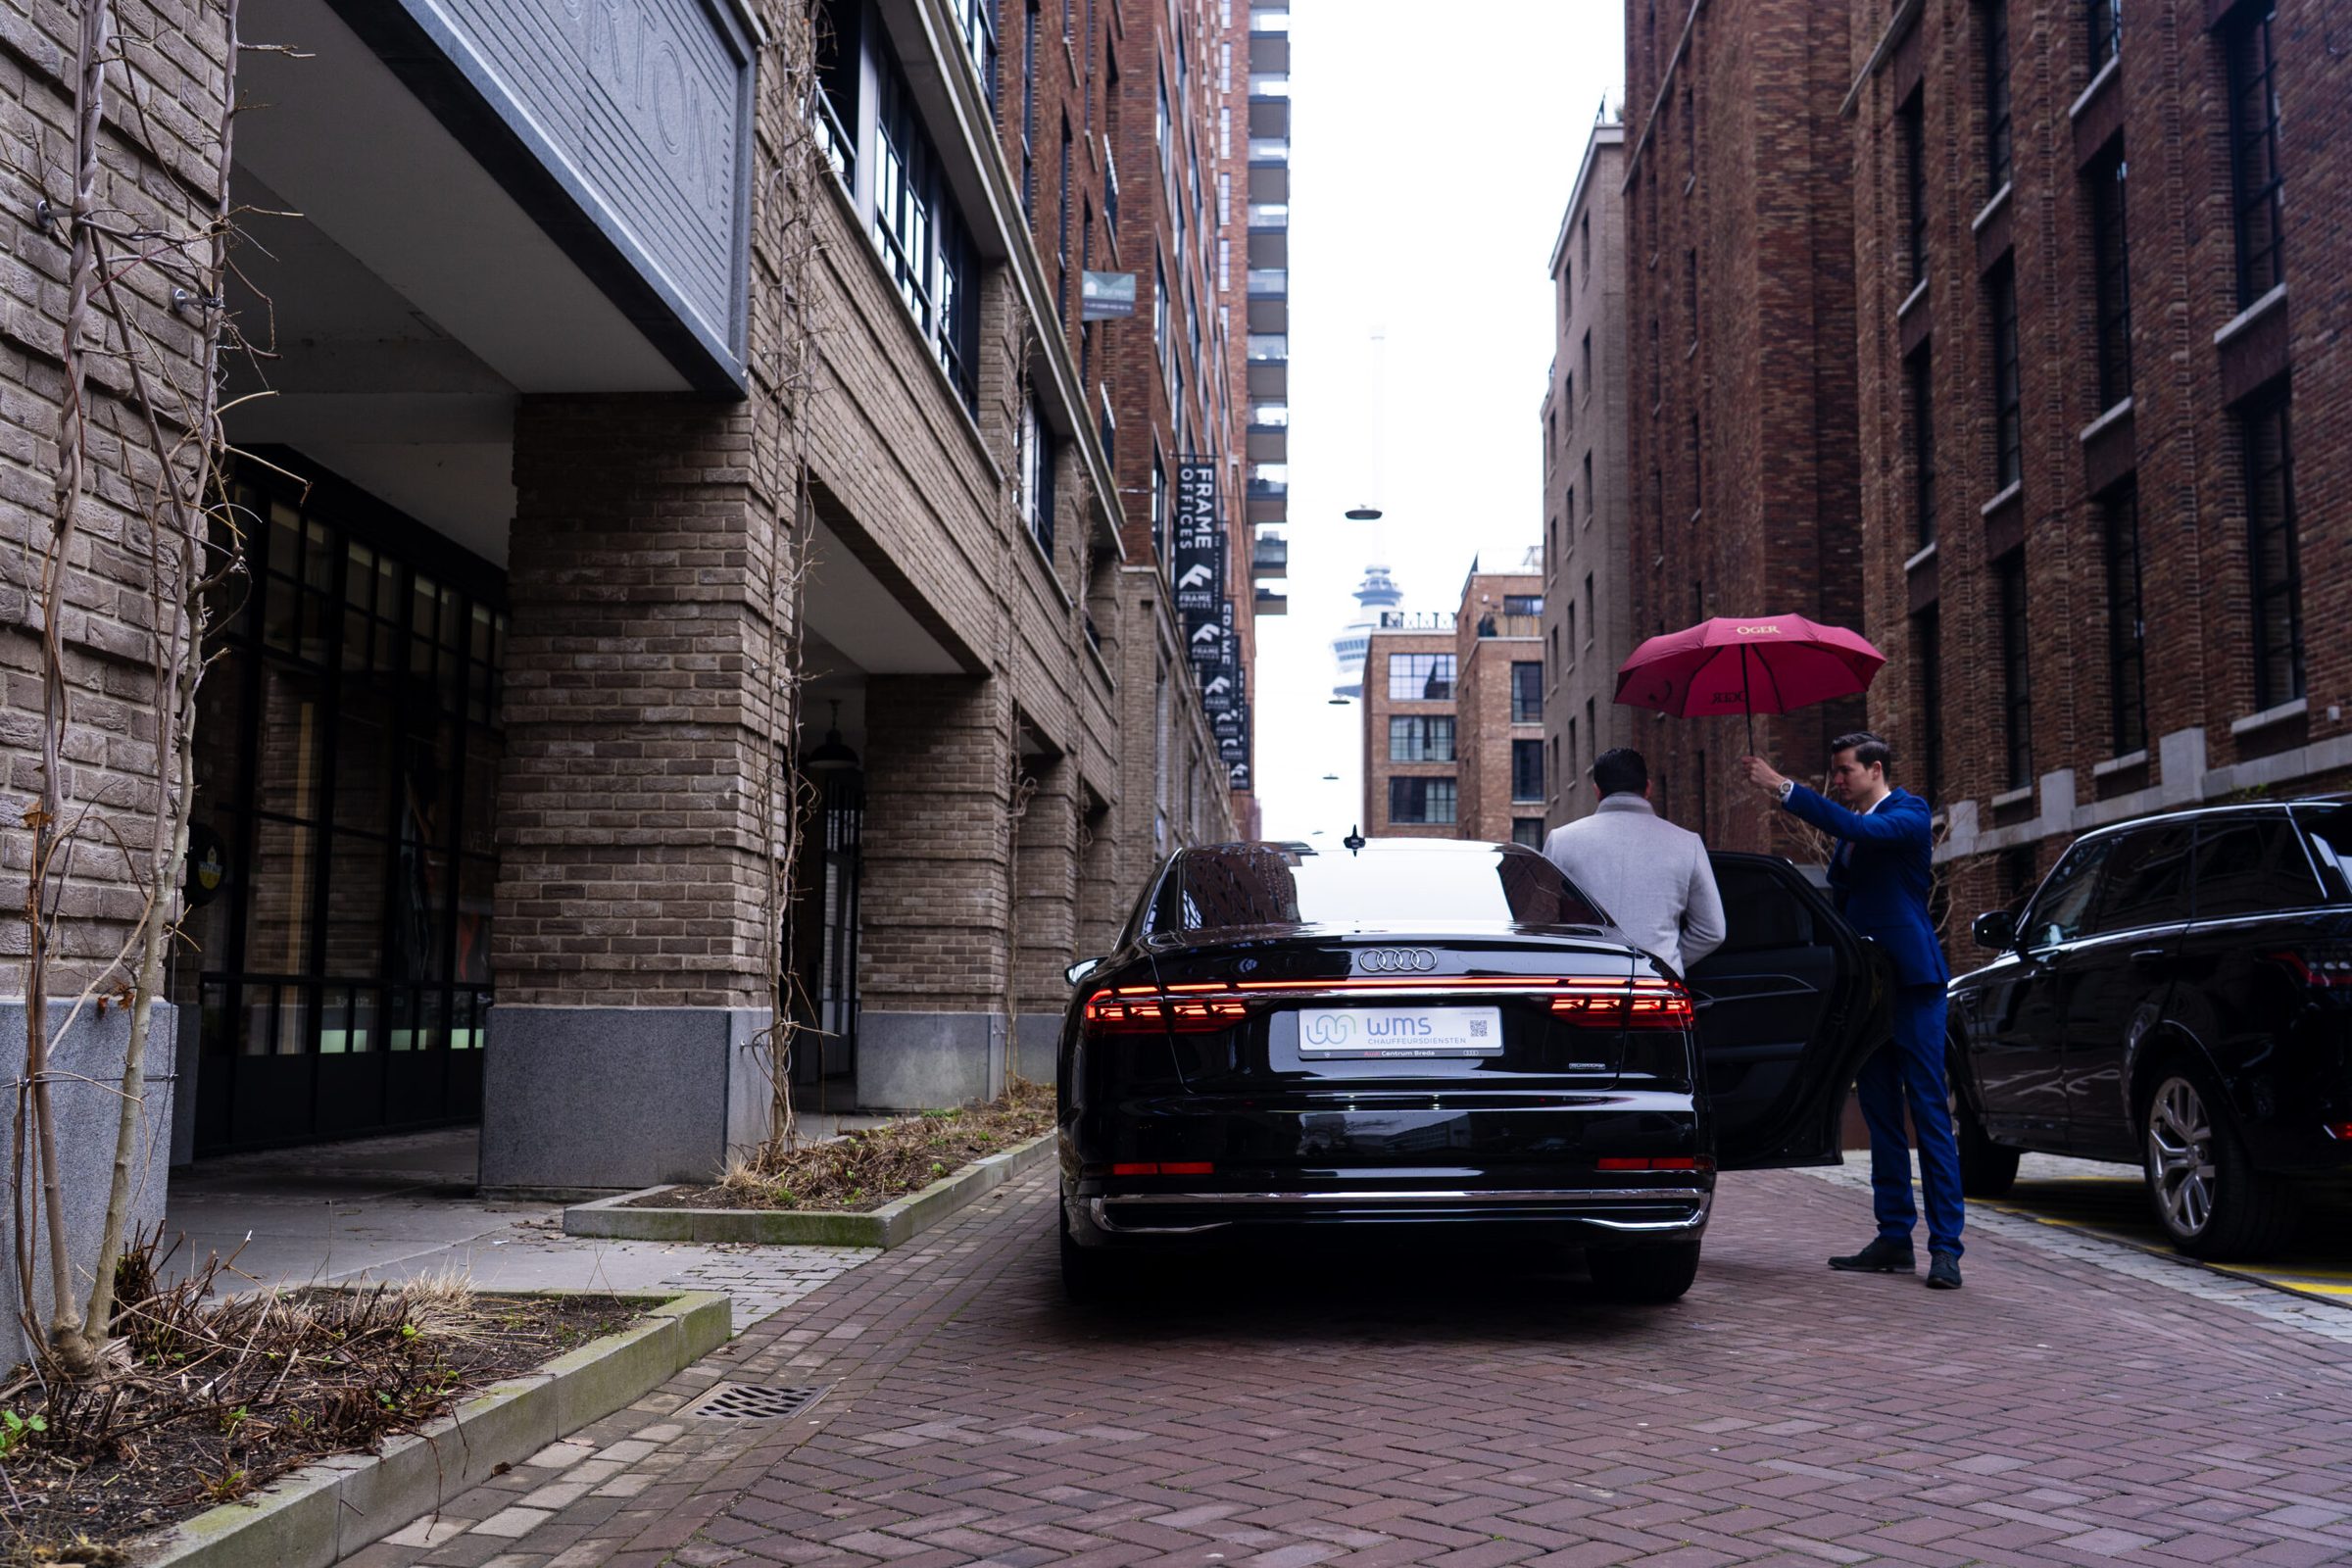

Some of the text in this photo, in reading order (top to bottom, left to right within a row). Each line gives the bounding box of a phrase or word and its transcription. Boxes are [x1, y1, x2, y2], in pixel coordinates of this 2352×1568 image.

[564, 0, 717, 210] RTON
[1180, 469, 1194, 549] OFFICES
[1196, 469, 1213, 549] FRAME
[1737, 625, 1781, 636] OGER
[1367, 1016, 1432, 1036] wms
